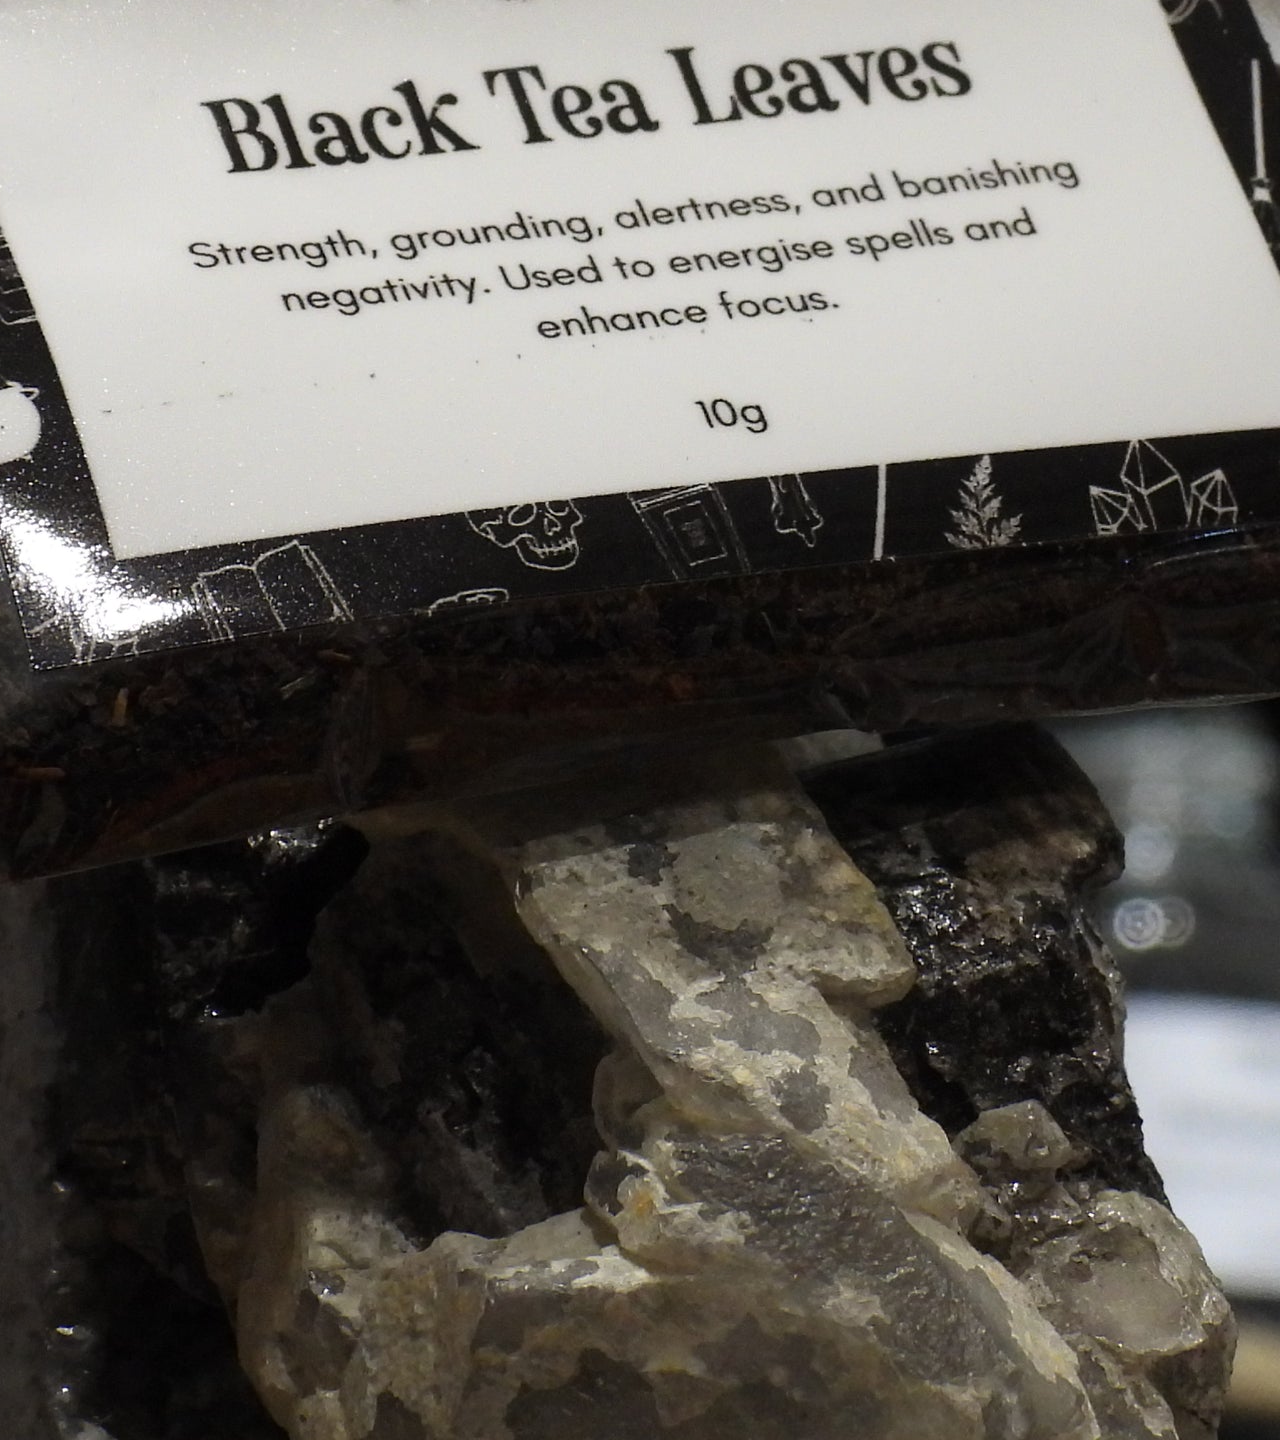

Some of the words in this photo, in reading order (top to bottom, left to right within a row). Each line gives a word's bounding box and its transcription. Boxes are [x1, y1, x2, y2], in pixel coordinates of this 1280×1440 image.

[200, 79, 481, 174] Black
[482, 65, 661, 145] Tea
[665, 41, 973, 127] Leaves
[187, 228, 379, 270] Strength,
[390, 211, 604, 262] grounding,
[614, 190, 802, 232] alertness,
[811, 171, 886, 208] and
[891, 153, 1081, 200] banishing
[280, 268, 493, 317] negativity.
[497, 251, 604, 292] Used
[612, 256, 656, 280] to
[668, 236, 835, 278] energise
[845, 216, 956, 262] spells
[963, 207, 1038, 242] and
[536, 298, 708, 340] enhance
[717, 289, 841, 320] focus.
[694, 397, 770, 434] 10g
